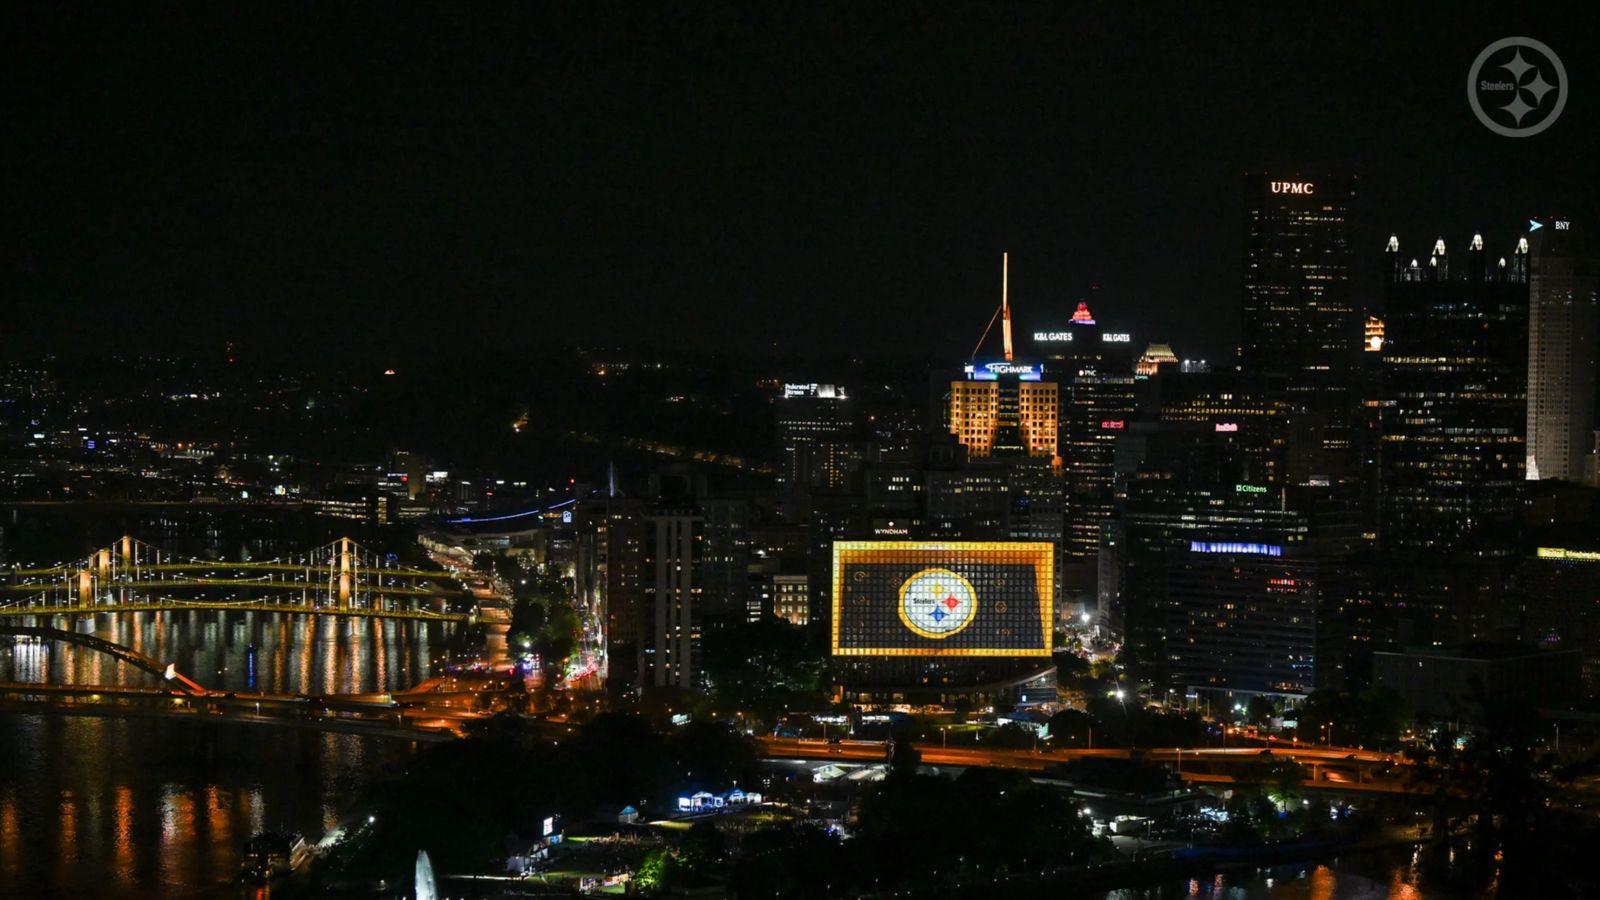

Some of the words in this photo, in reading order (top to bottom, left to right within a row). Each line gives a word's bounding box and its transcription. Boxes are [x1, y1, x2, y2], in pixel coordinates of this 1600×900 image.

[1270, 181, 1314, 194] UPMC
[1555, 221, 1570, 230] BNY
[1034, 332, 1048, 341] K&L
[1048, 332, 1073, 341] GATES
[1113, 333, 1130, 342] GATES
[1242, 485, 1267, 493] Citizens
[912, 597, 936, 605] Steelers
